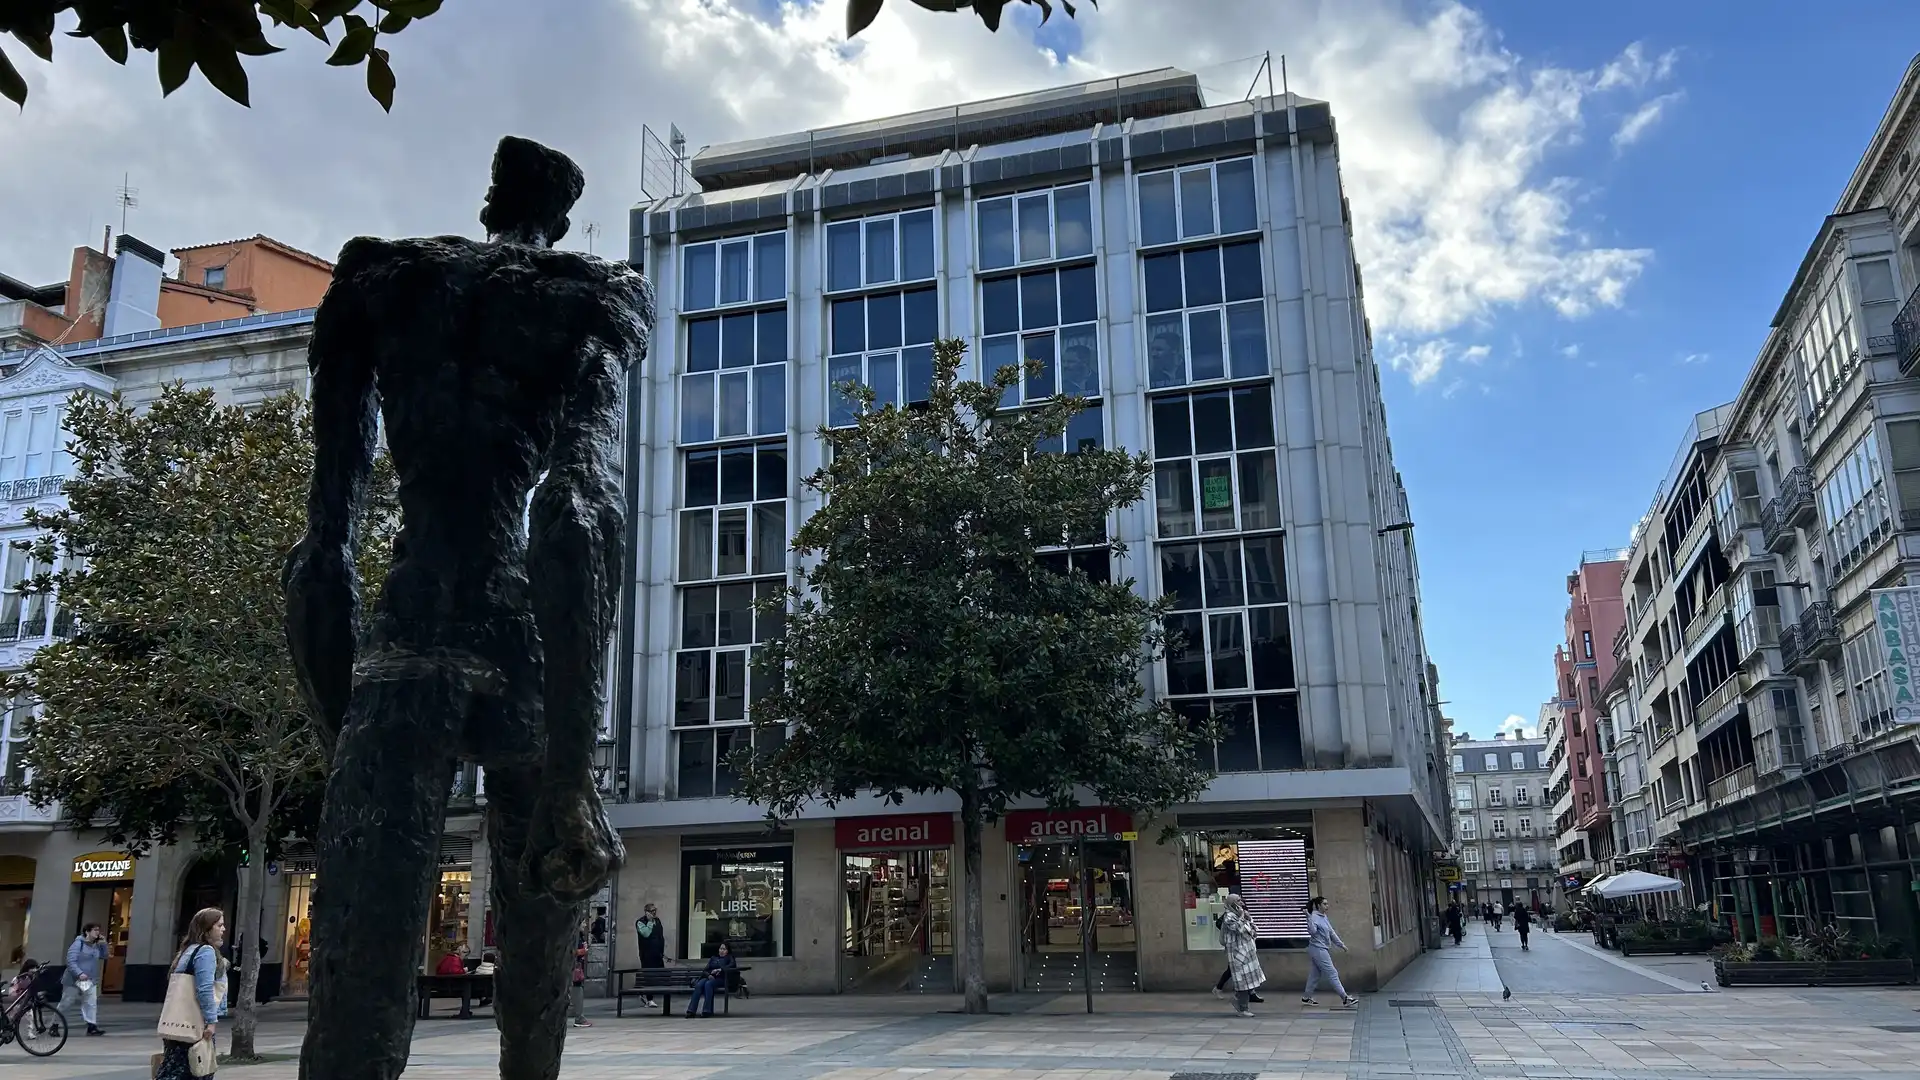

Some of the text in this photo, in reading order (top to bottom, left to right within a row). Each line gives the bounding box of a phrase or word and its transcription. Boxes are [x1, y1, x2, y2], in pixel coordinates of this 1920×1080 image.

[1878, 593, 1914, 704] ANBASA
[857, 820, 929, 842] arenal
[1030, 813, 1107, 836] arenal
[721, 900, 756, 912] LIBRE
